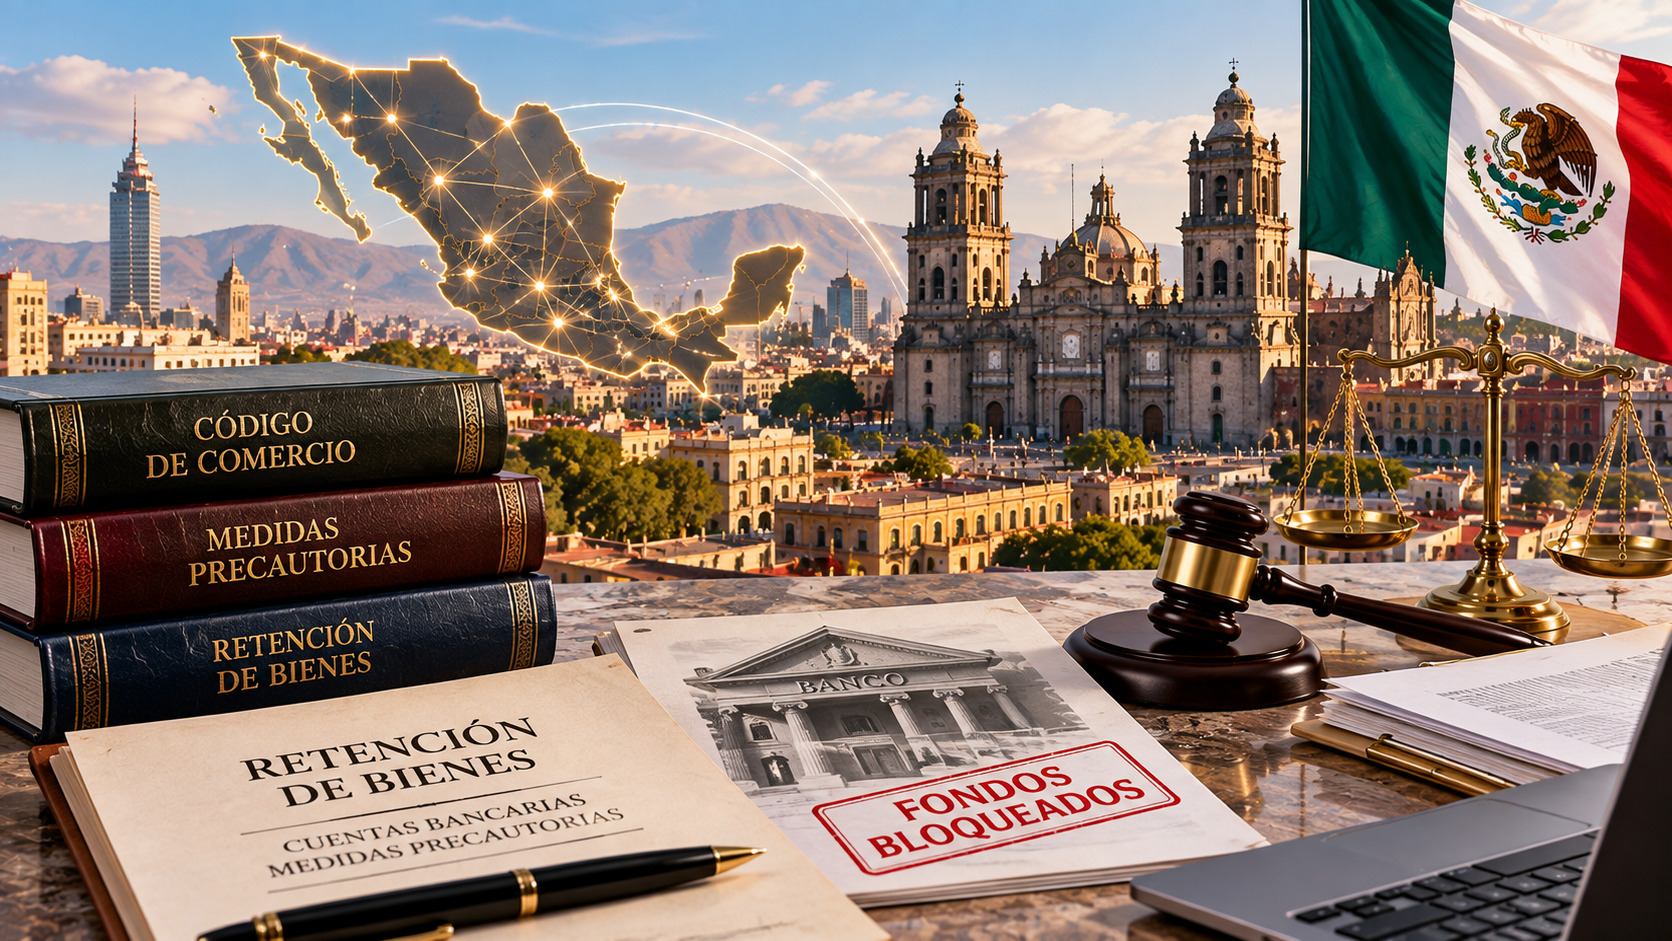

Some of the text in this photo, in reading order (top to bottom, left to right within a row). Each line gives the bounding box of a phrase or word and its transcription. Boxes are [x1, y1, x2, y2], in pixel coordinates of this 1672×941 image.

[194, 410, 312, 440] CÓDIGO
[146, 440, 356, 478] DE COMERCIO
[207, 517, 339, 551] MEDIDAS
[189, 541, 412, 586] PRECAUTORIAS
[213, 618, 374, 662] RETENCIÓN
[217, 652, 371, 693] DE BIENES
[796, 672, 907, 694] BANCO
[240, 717, 538, 780] RETENCIÓN
[278, 749, 536, 807] DE BIENES
[894, 766, 1072, 821] FONDOS
[282, 793, 587, 853] CUENTAS BANCARIAS
[868, 779, 1145, 858] BLOQUEADOS
[267, 807, 625, 878] MEDIDAS PRECAUTORIAS
